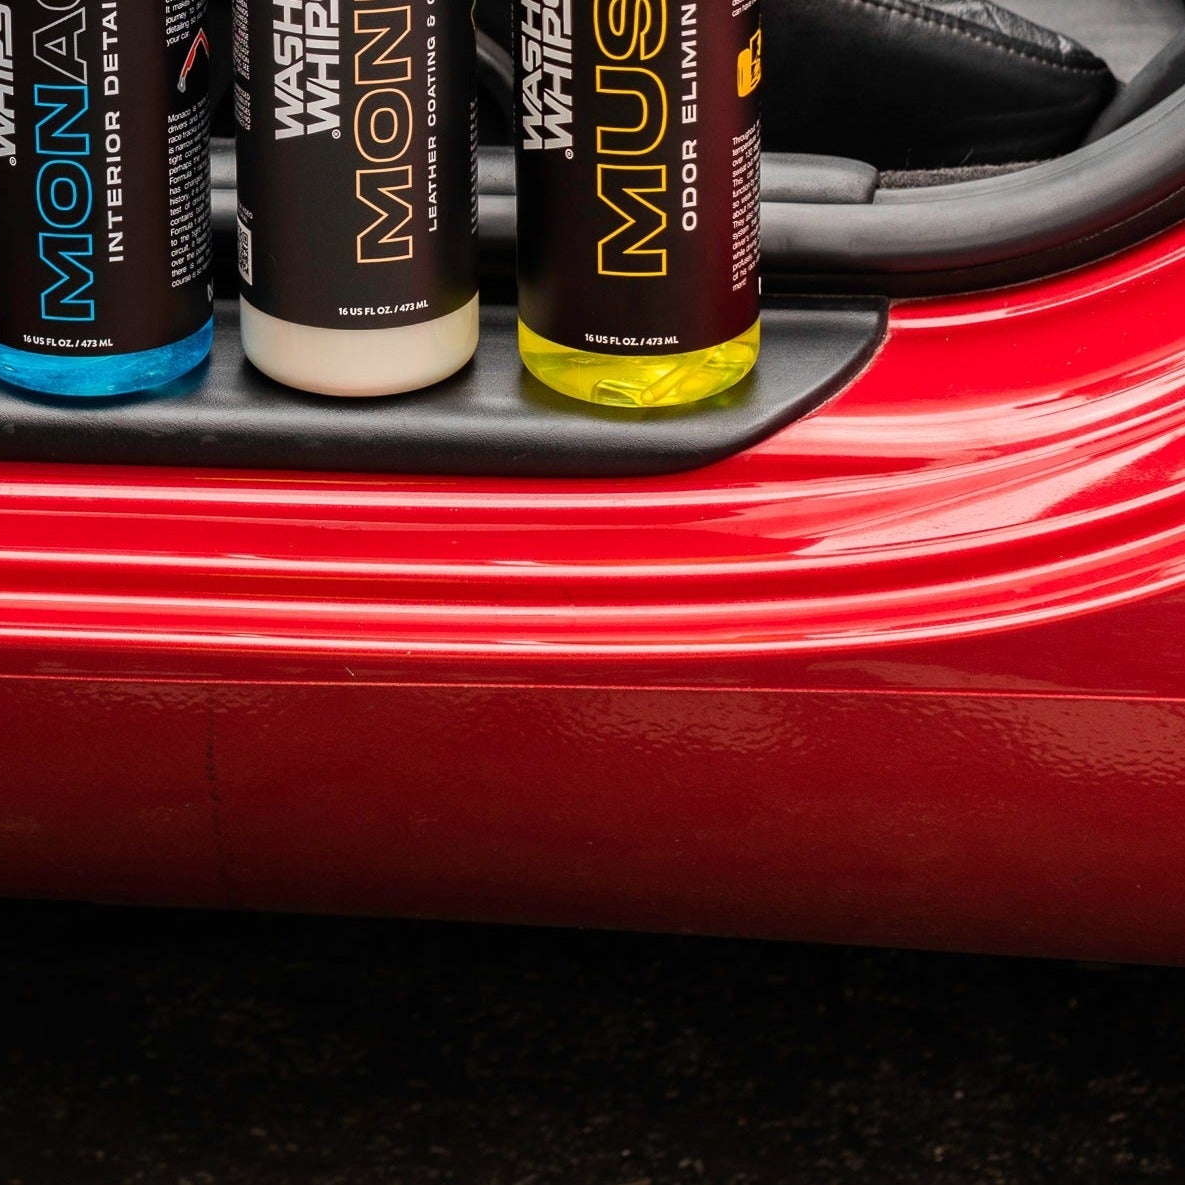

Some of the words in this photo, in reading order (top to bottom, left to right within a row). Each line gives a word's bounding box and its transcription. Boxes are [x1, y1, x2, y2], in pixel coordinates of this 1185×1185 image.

[427, 15, 436, 28] &
[427, 36, 437, 127] COATING
[104, 111, 124, 262] INTERIOR
[427, 135, 438, 232] LEATHER
[682, 139, 697, 232] ODOR
[338, 306, 348, 316] 16
[350, 306, 362, 316] US
[364, 306, 376, 316] FL
[377, 305, 393, 316] OZ.
[399, 302, 415, 313] 473
[416, 299, 429, 310] ML
[23, 334, 32, 344] 16
[32, 336, 45, 346] US
[46, 337, 58, 347] FL
[57, 338, 74, 348] OZ.
[81, 339, 98, 348] 473
[99, 337, 114, 348] ML
[584, 333, 594, 343] 16
[595, 334, 608, 344] US
[610, 336, 622, 345] FL
[622, 336, 639, 346] OZ.
[646, 337, 663, 346] 473
[664, 335, 679, 345] ML
